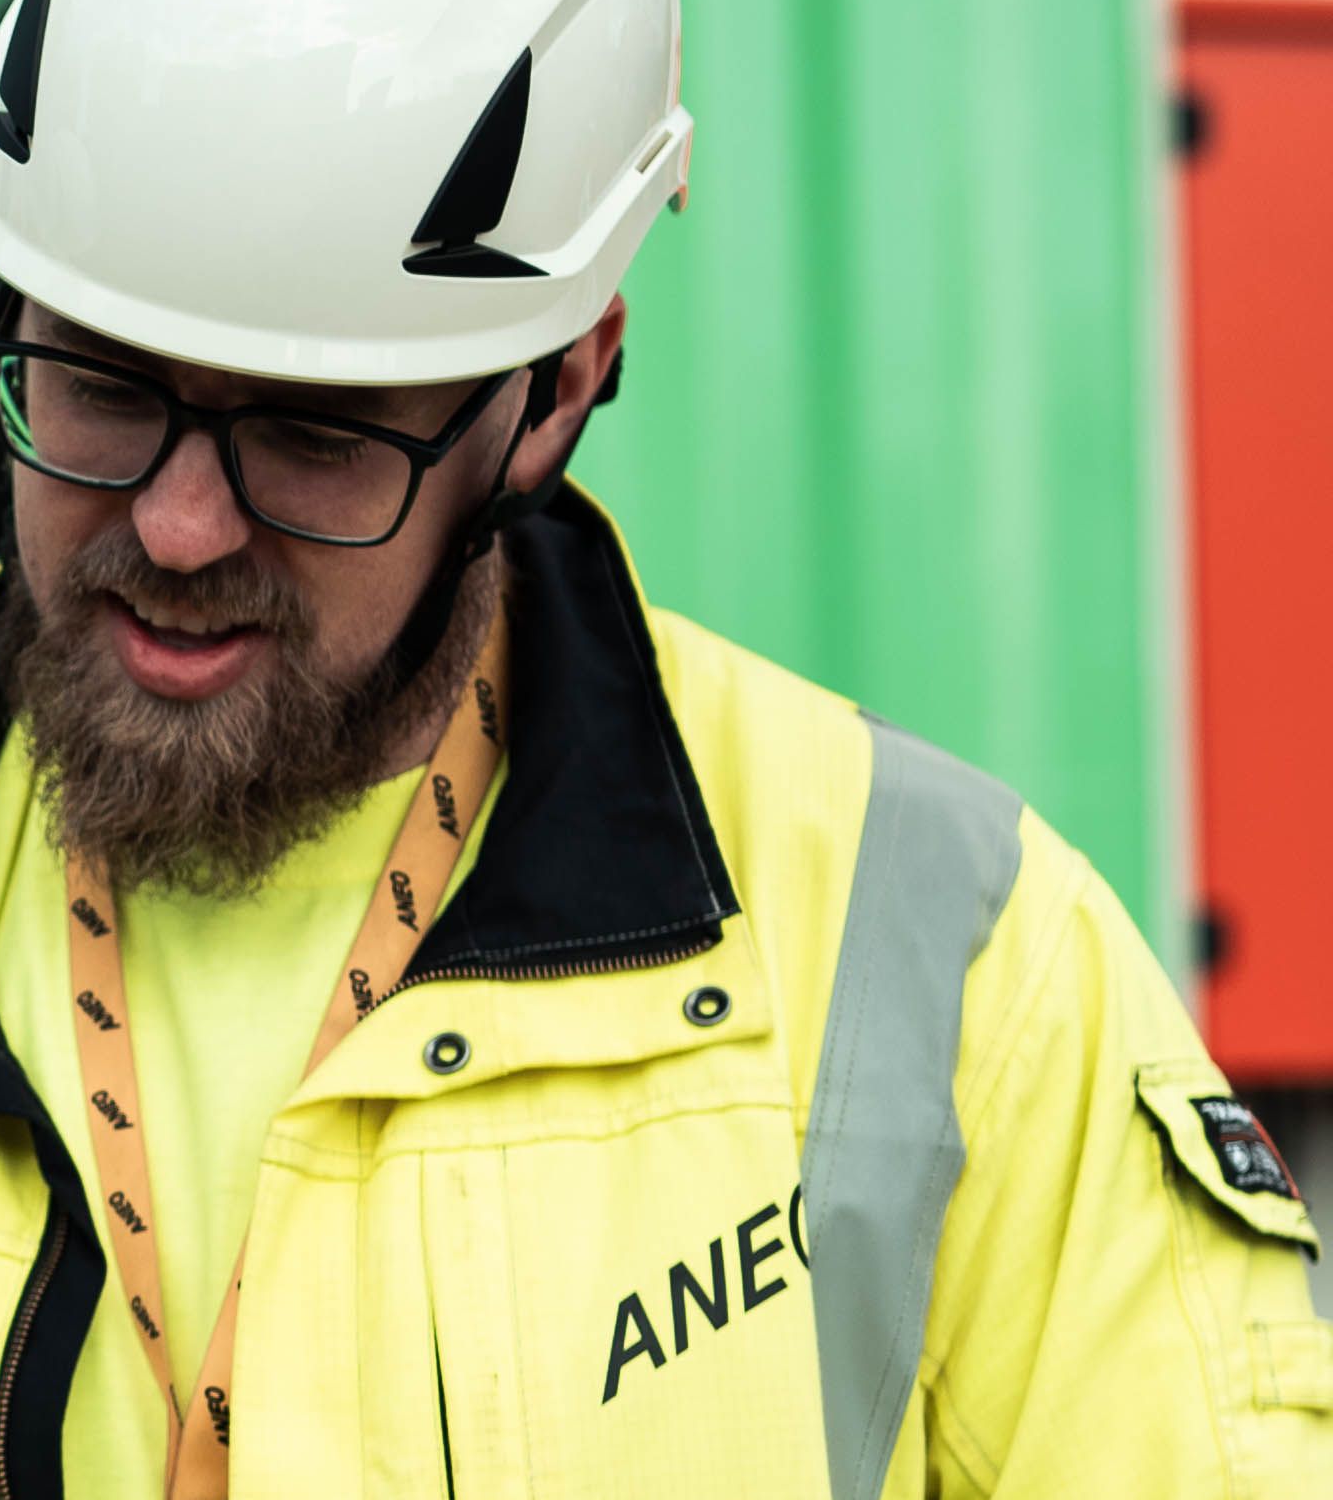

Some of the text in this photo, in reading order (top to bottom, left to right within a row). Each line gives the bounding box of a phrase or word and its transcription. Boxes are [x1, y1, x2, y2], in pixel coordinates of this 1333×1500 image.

[432, 774, 461, 841] ANEO
[389, 870, 420, 933] ANEO
[91, 1090, 134, 1131] ANEO
[109, 1191, 148, 1235] ANEO
